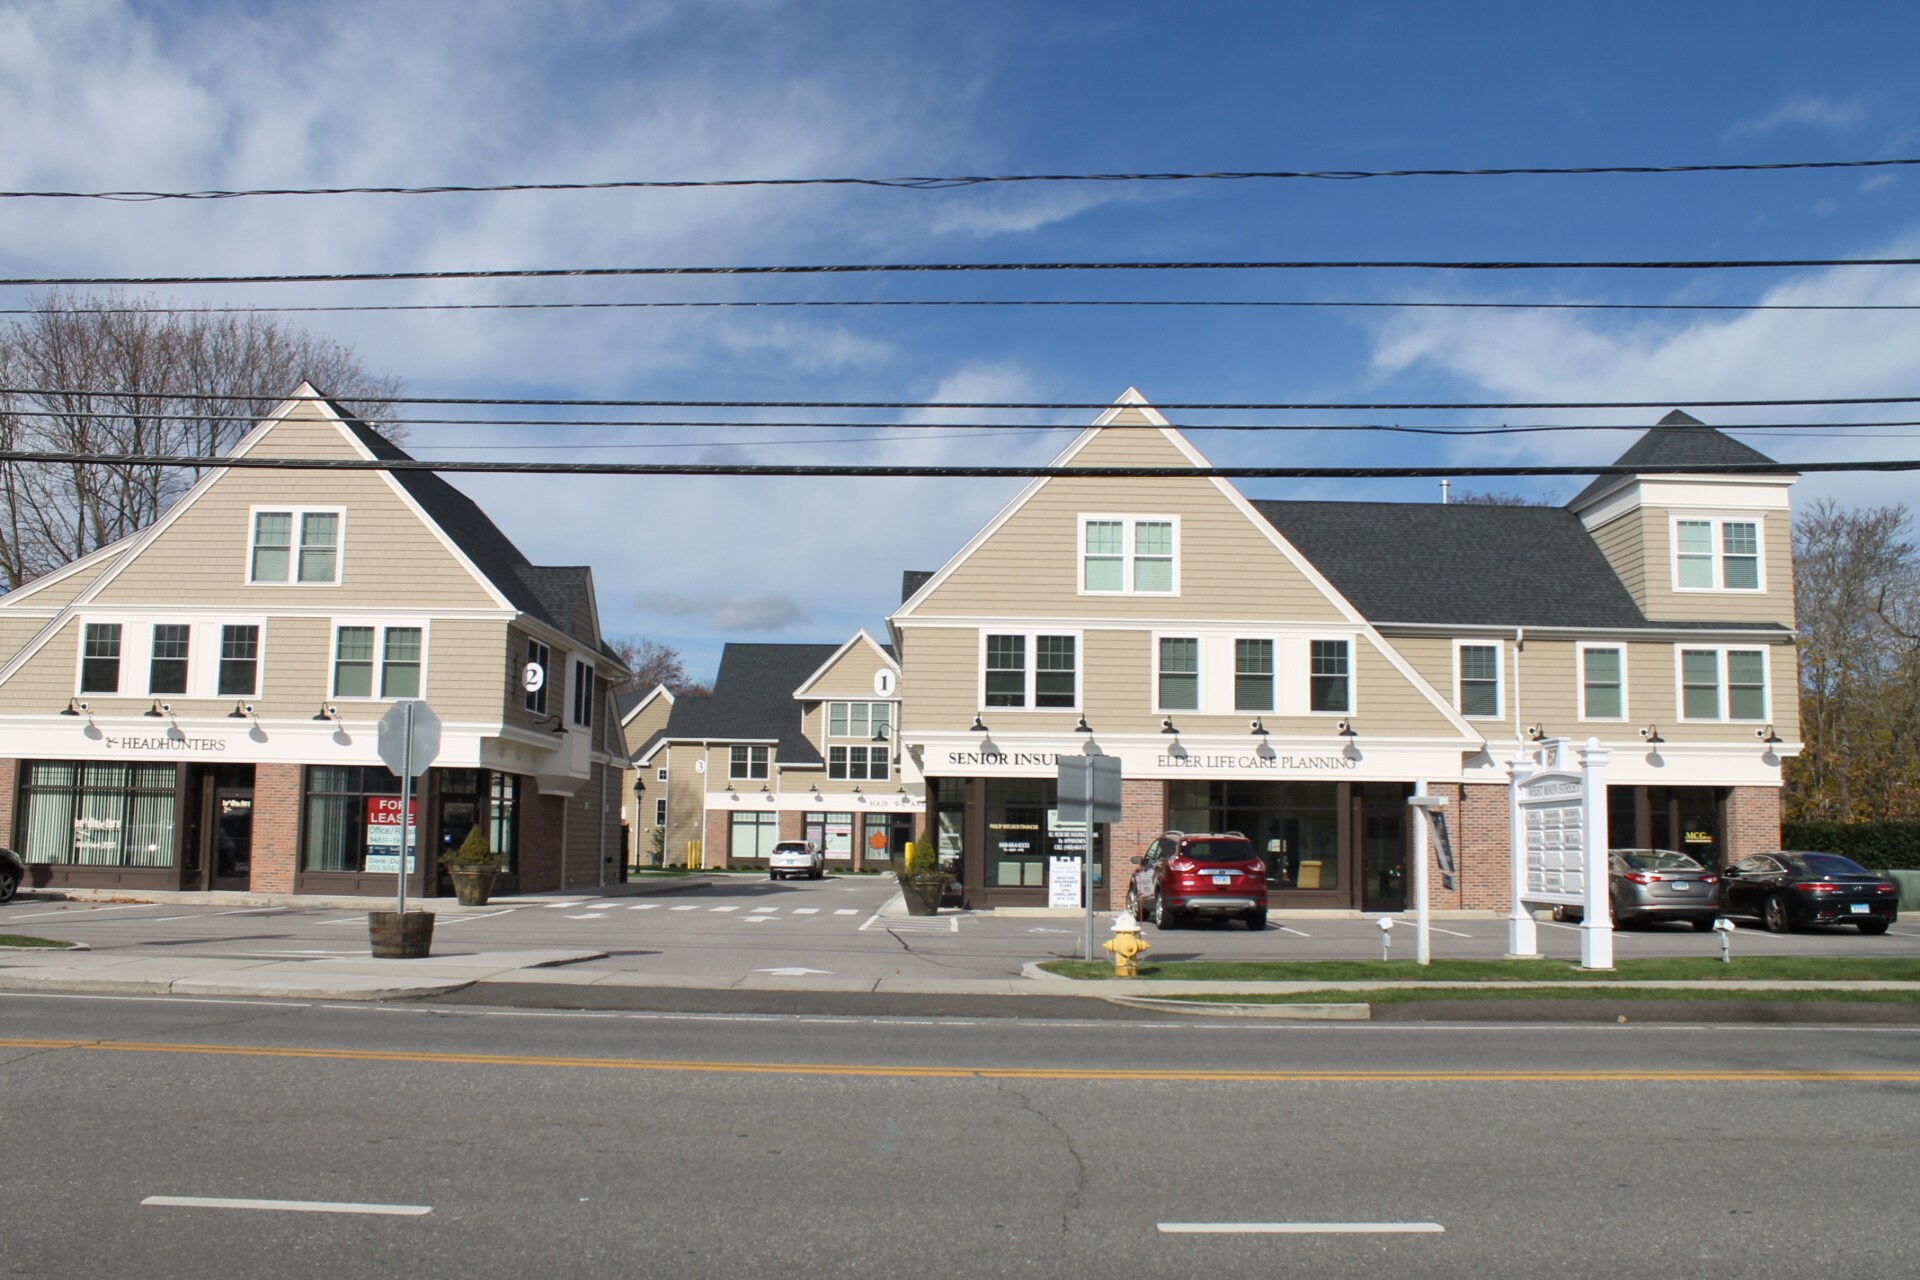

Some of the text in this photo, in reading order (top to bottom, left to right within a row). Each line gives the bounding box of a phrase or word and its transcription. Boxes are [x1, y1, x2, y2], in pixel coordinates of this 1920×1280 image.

[525, 669, 538, 685] 2
[880, 675, 888, 691] 1
[121, 737, 226, 751] HEADHUNTERS
[949, 752, 1009, 765] SENIOR
[1157, 755, 1357, 769] ELDER LIFE CARE PLANNING
[1547, 749, 1557, 767] 67
[698, 762, 704, 772] 3
[1544, 784, 1557, 795] MAIN
[370, 813, 414, 824] LEASE
